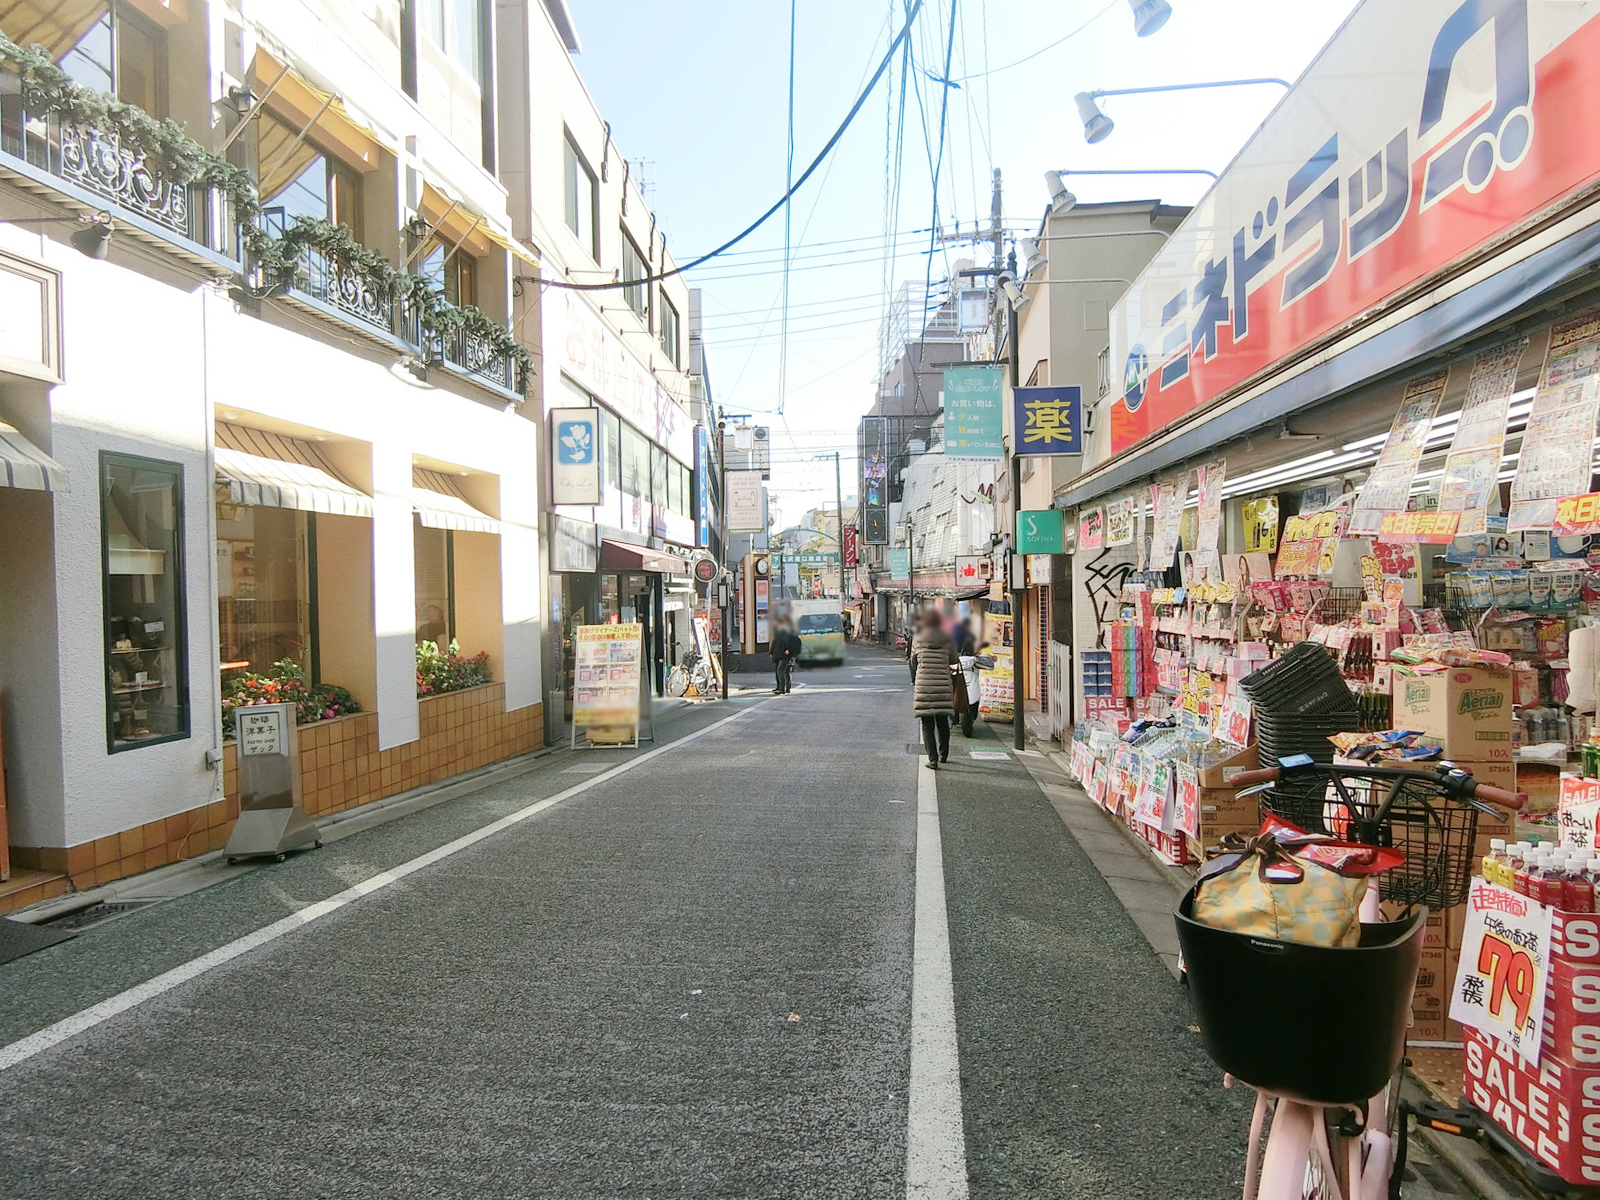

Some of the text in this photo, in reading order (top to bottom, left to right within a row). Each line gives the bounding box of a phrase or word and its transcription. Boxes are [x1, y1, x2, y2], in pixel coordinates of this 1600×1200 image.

[1023, 399, 1073, 444] 薬
[1556, 495, 1600, 526] 本日
[959, 564, 976, 578] 油
[1088, 698, 1124, 709] SALE
[1459, 691, 1501, 712] Aerial
[1562, 785, 1600, 807] SALE!
[1250, 938, 1285, 949] Panasonic
[1477, 931, 1534, 1032] 79
[1524, 1015, 1536, 1041] 円
[1466, 1040, 1550, 1130] SALE
[1472, 1080, 1560, 1169] SALE
